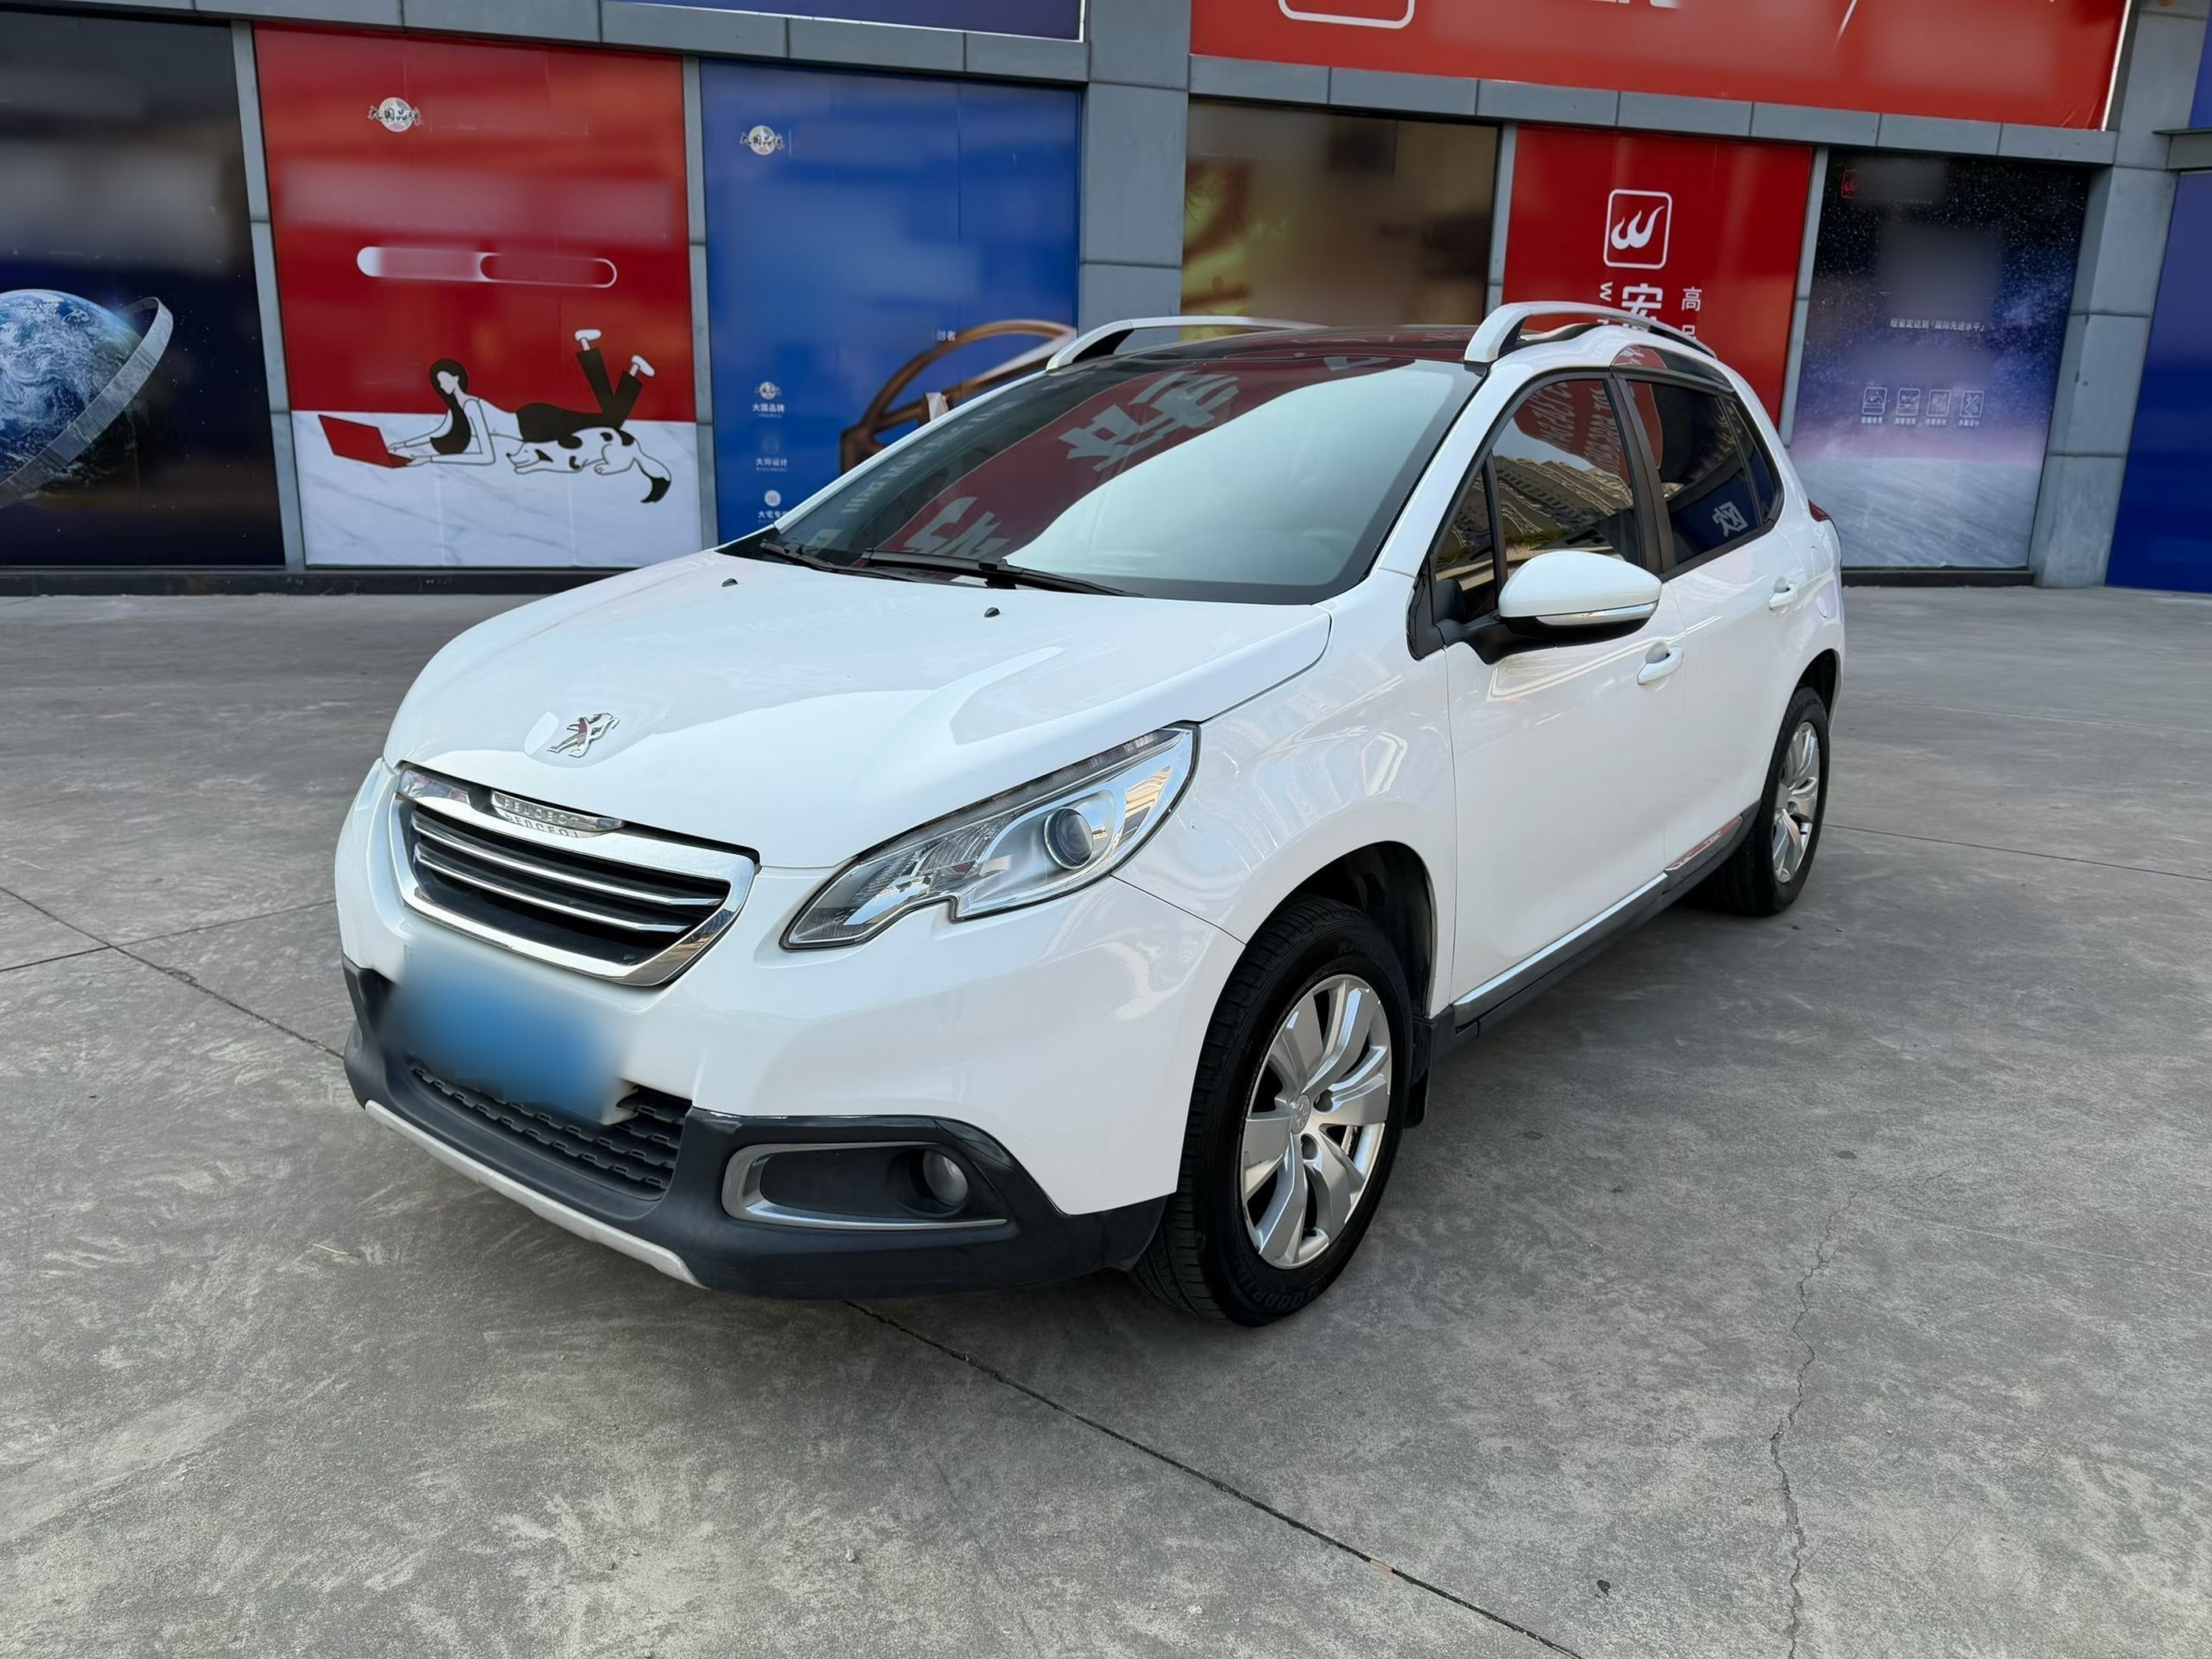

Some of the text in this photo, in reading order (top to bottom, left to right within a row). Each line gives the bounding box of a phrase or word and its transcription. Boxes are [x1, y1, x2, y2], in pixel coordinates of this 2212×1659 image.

[757, 510, 788, 519] 大宅专
[503, 798, 579, 827] PEUGEOT
